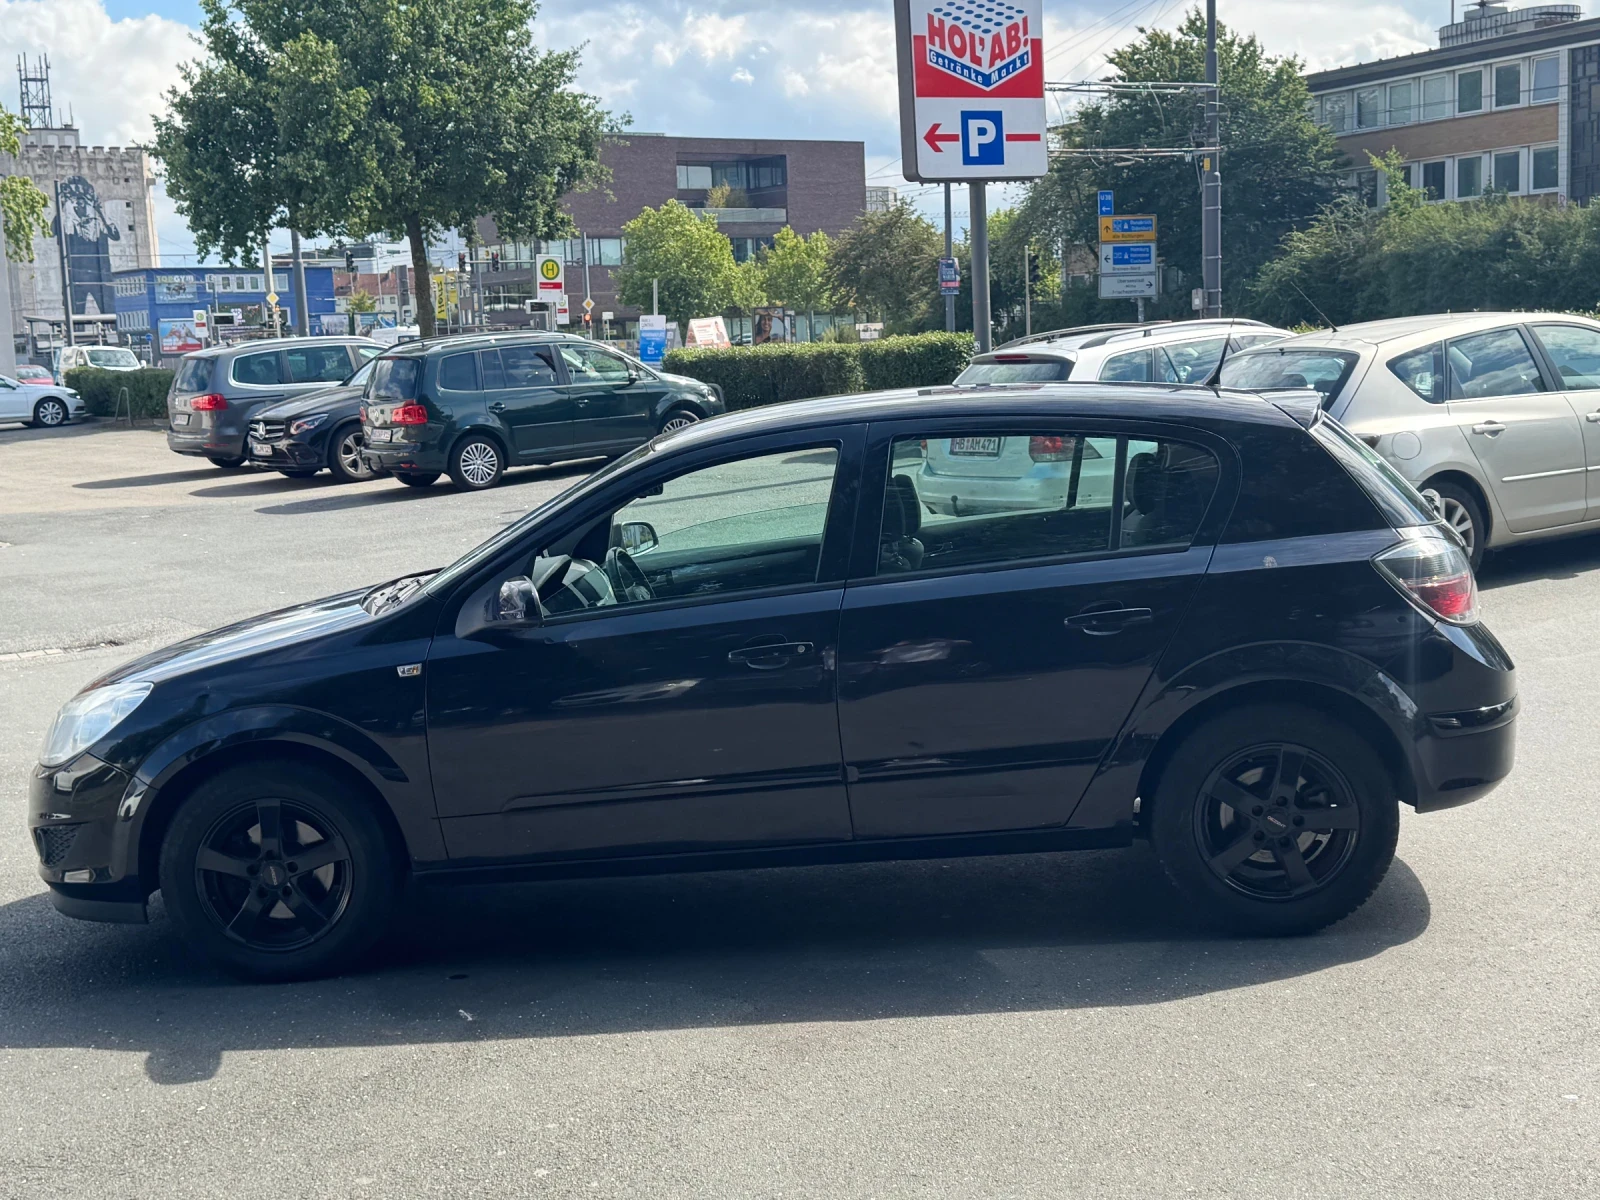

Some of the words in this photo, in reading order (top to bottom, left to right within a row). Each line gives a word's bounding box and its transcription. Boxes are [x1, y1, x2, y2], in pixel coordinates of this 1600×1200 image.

[930, 51, 983, 84] Getränke
[991, 54, 1029, 84] Markt
[967, 119, 997, 157] P
[955, 438, 965, 450] HB
[981, 438, 996, 451] 471
